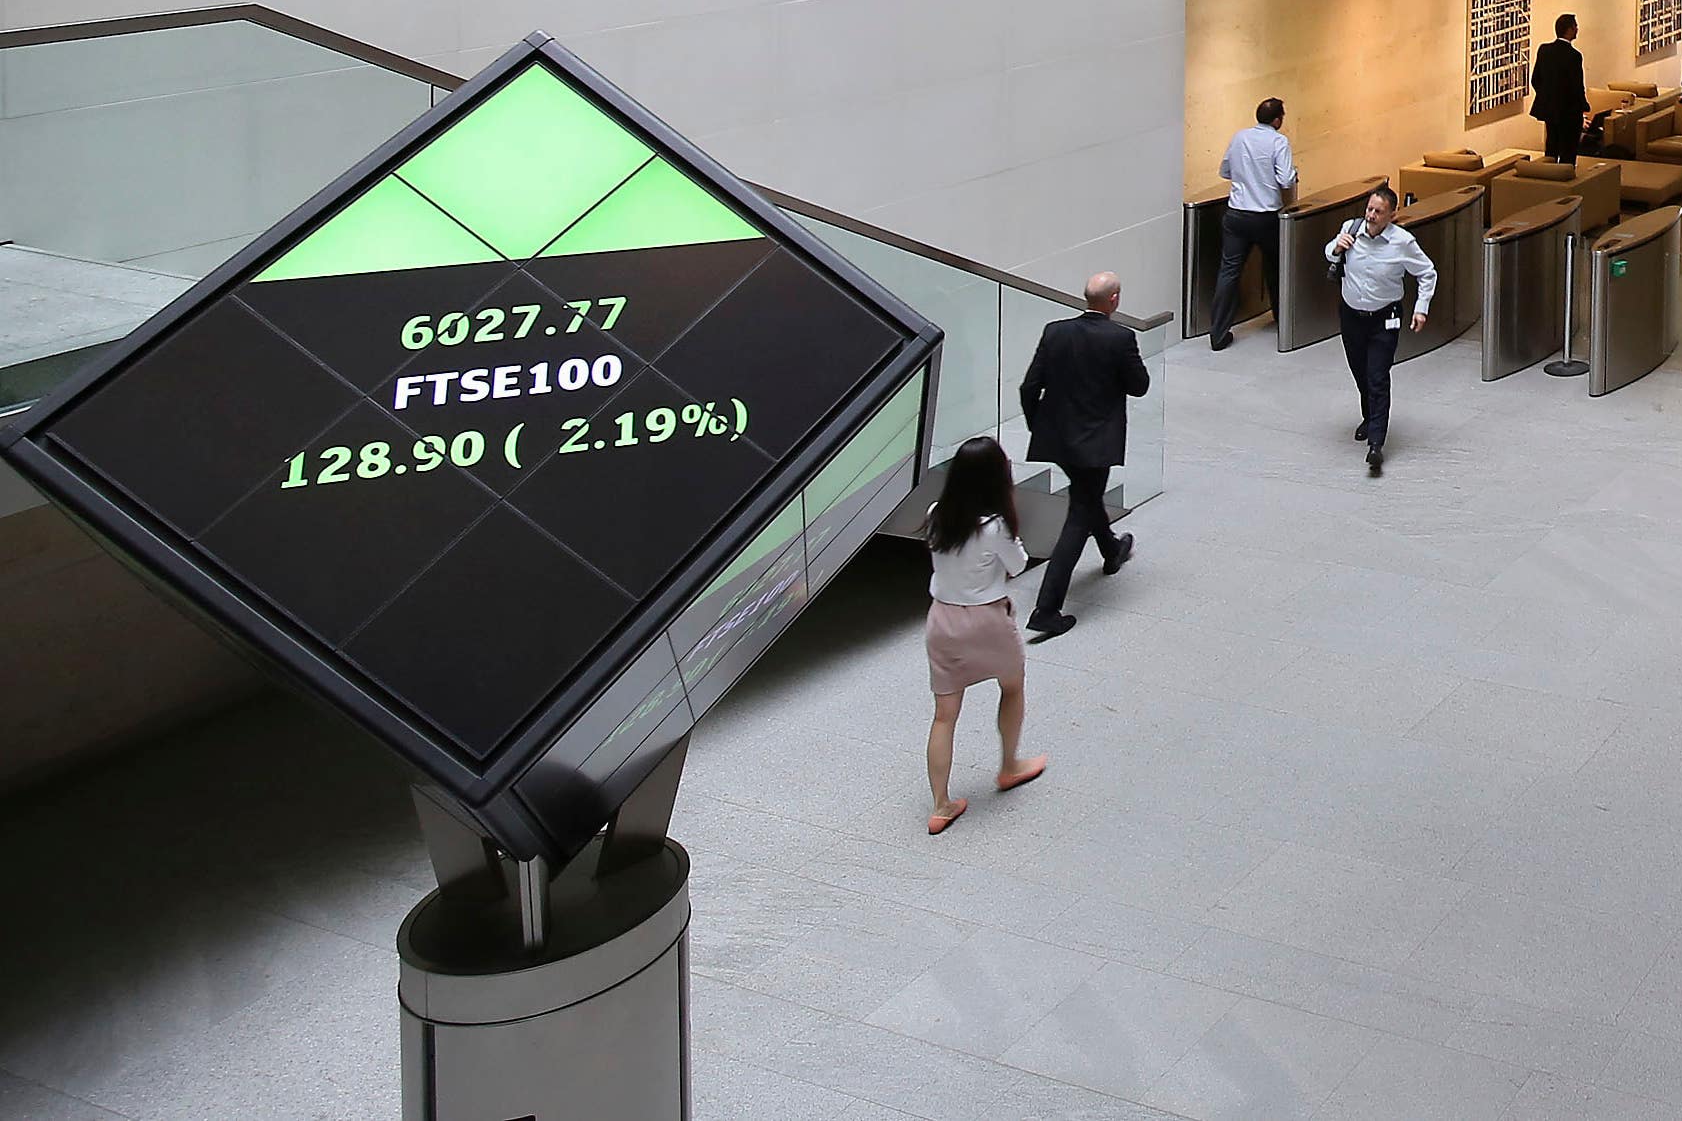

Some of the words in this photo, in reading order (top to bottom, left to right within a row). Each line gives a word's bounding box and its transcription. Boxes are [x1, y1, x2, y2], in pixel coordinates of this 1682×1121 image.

[400, 295, 630, 352] 6027.77
[392, 354, 625, 410] FTSE100
[279, 428, 487, 490] 128.90
